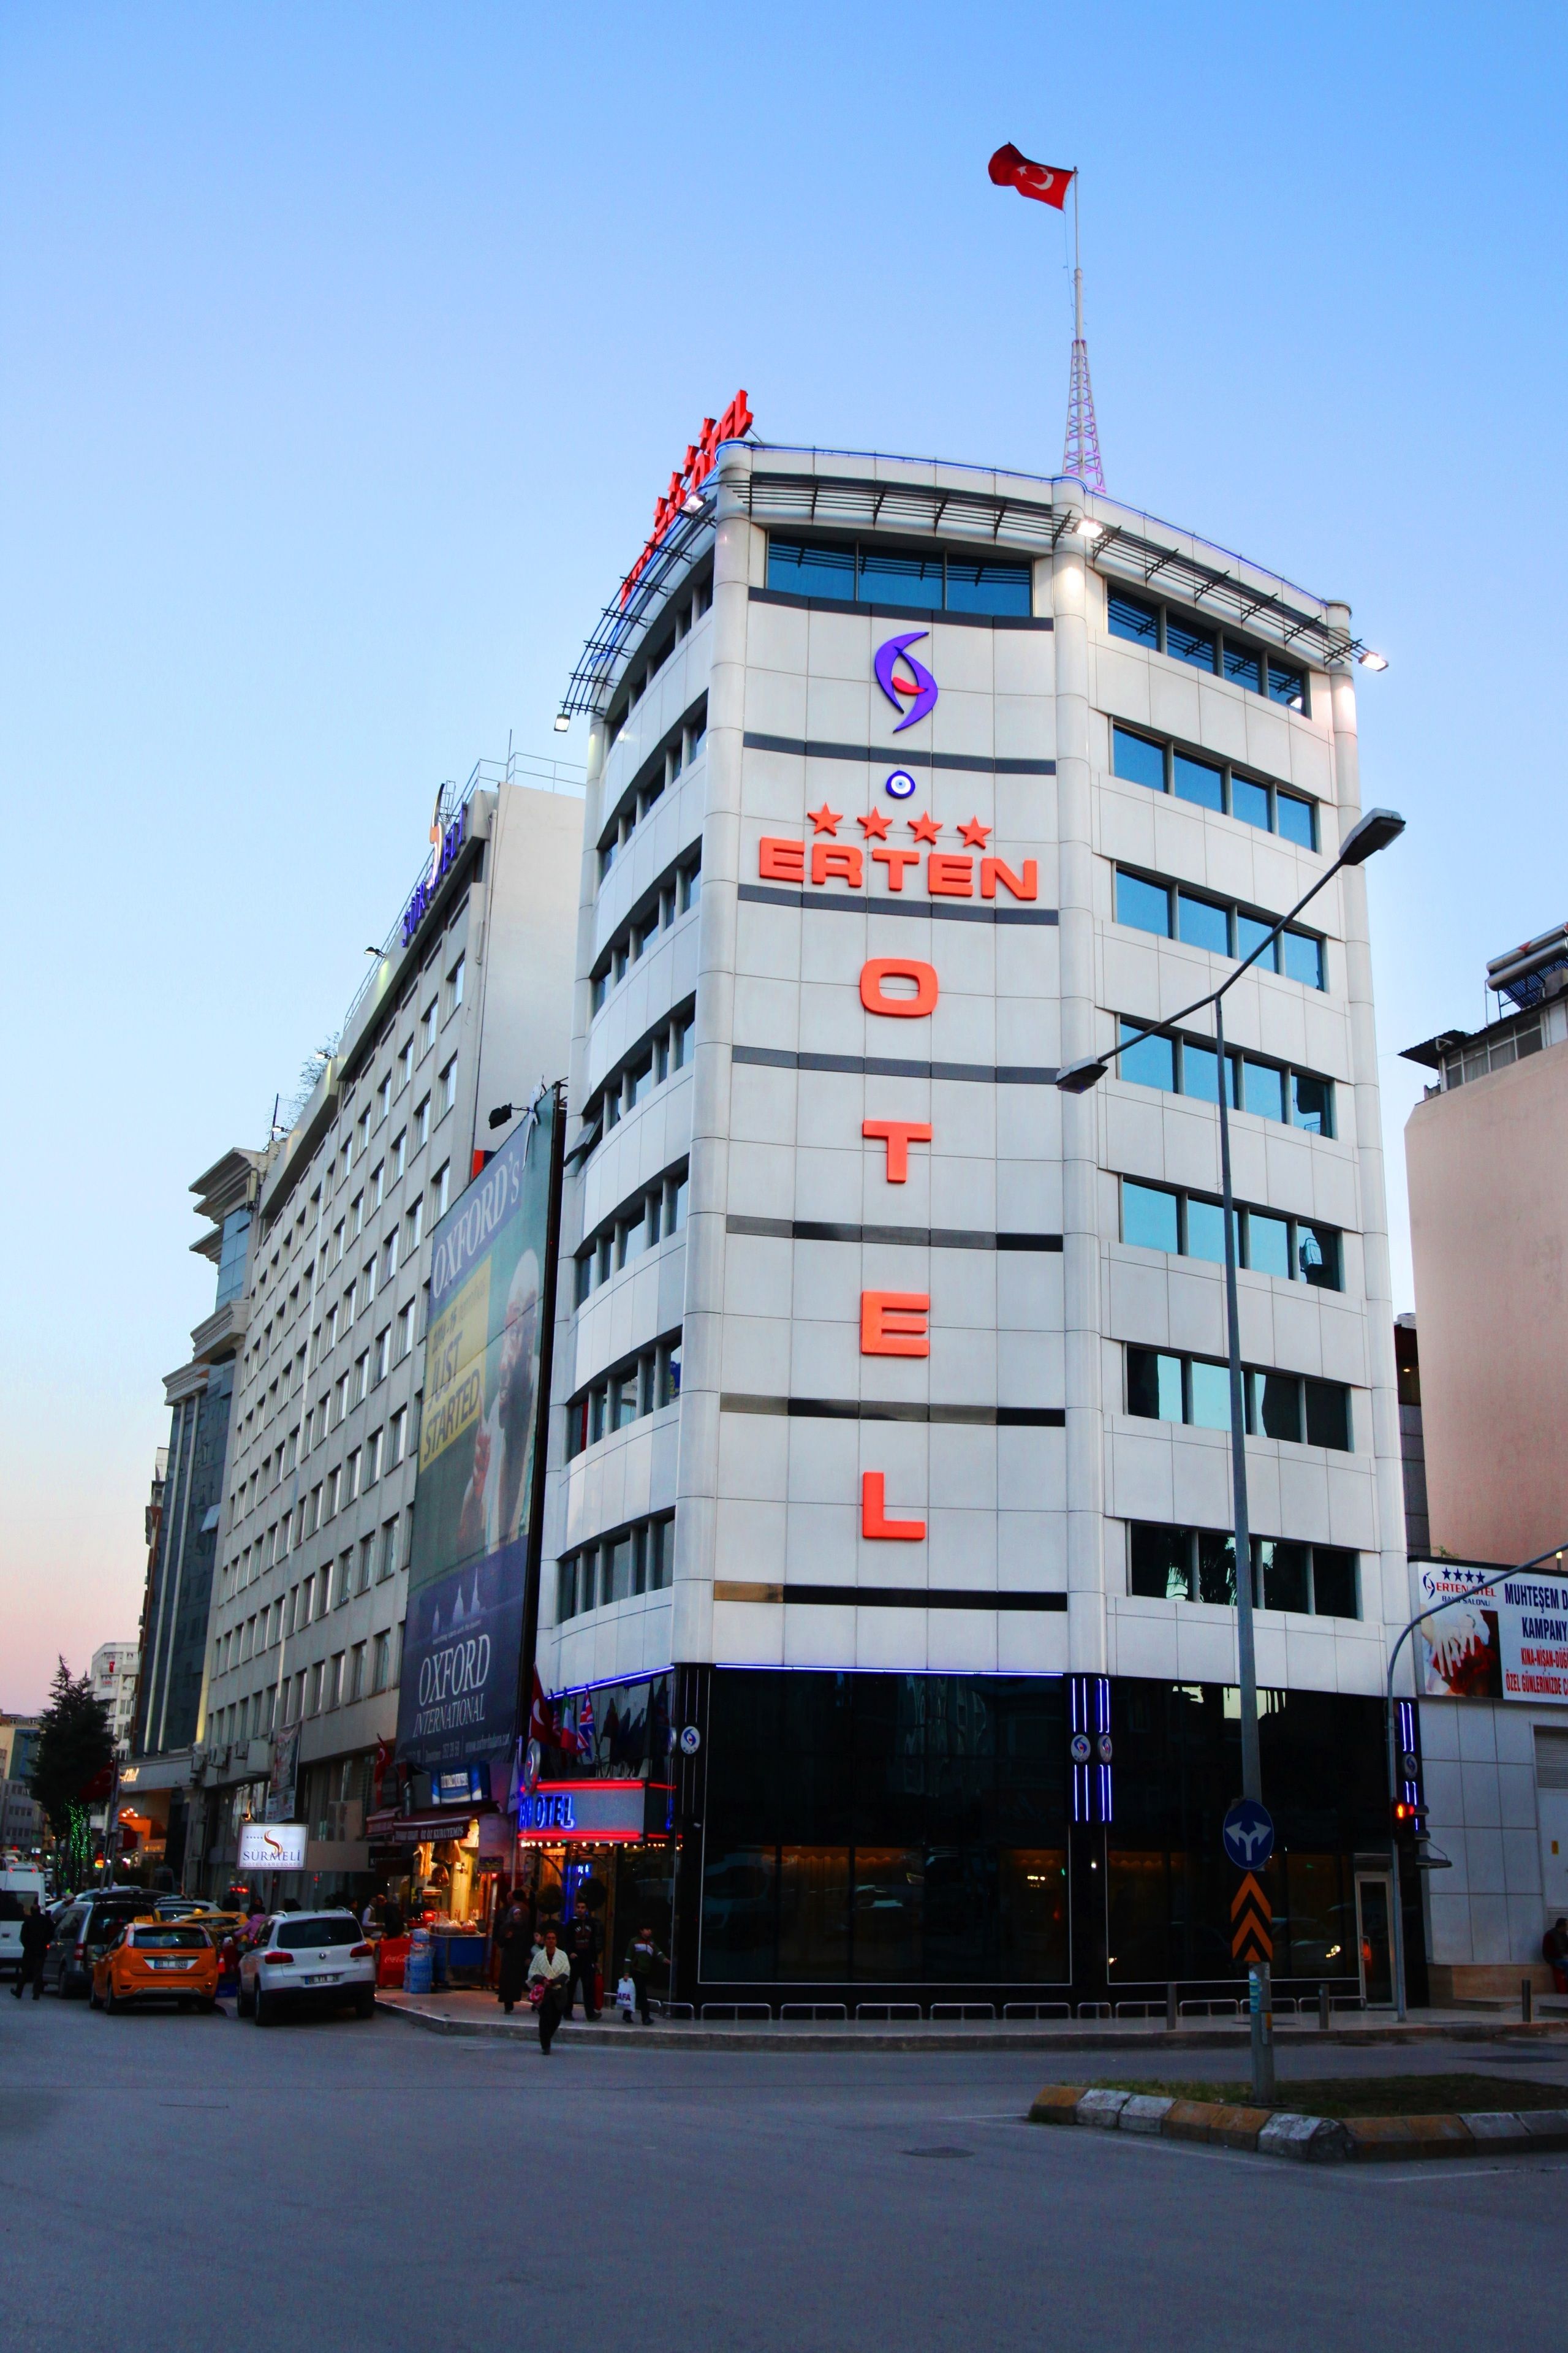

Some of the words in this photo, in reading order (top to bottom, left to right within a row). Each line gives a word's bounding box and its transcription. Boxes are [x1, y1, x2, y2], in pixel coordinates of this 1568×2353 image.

[759, 836, 1037, 901] ERTEN
[433, 1151, 520, 1298] OXFORD's
[428, 1330, 463, 1412] JUST
[423, 1368, 480, 1463] STARTED
[1436, 1582, 1469, 1594] ERTEN
[1463, 1597, 1490, 1607] SALONU
[1504, 1583, 1559, 1613] MUHTEŞEM
[1521, 1616, 1568, 1642] KAMPANY
[419, 1634, 490, 1707] OXFORD
[1520, 1645, 1568, 1672] KINA-NİŞAN-DÜĞ
[1506, 1669, 1521, 1692] ÖZEL
[1521, 1670, 1562, 1696] GÜNLERİNİZDE
[412, 1693, 485, 1738] INTERNATIONAL
[535, 1794, 576, 1829] OTEL
[243, 1849, 300, 1861] SÜRMELİ
